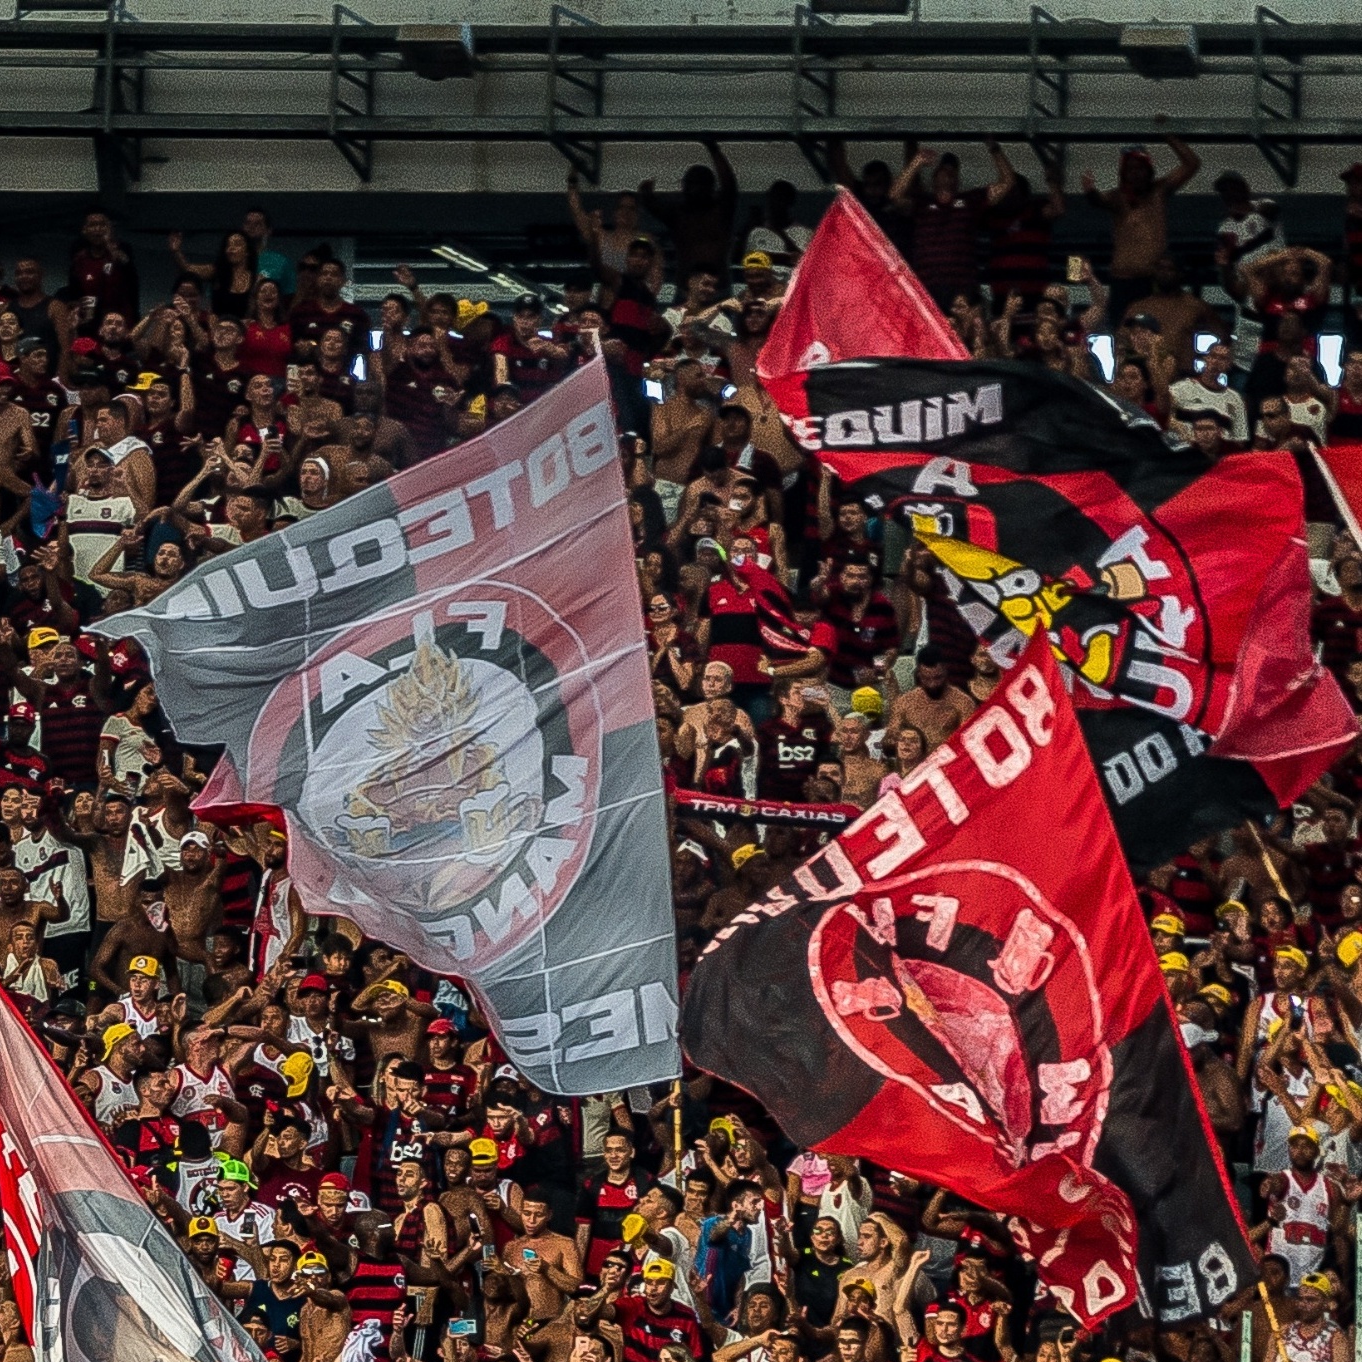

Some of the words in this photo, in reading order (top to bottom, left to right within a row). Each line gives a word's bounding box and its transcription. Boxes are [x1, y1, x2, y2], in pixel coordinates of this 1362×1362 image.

[778, 741, 815, 762] bs2
[1103, 732, 1178, 806] DO
[691, 799, 736, 814] TFM
[761, 806, 847, 823] CAXIAS
[390, 1140, 423, 1162] bs2
